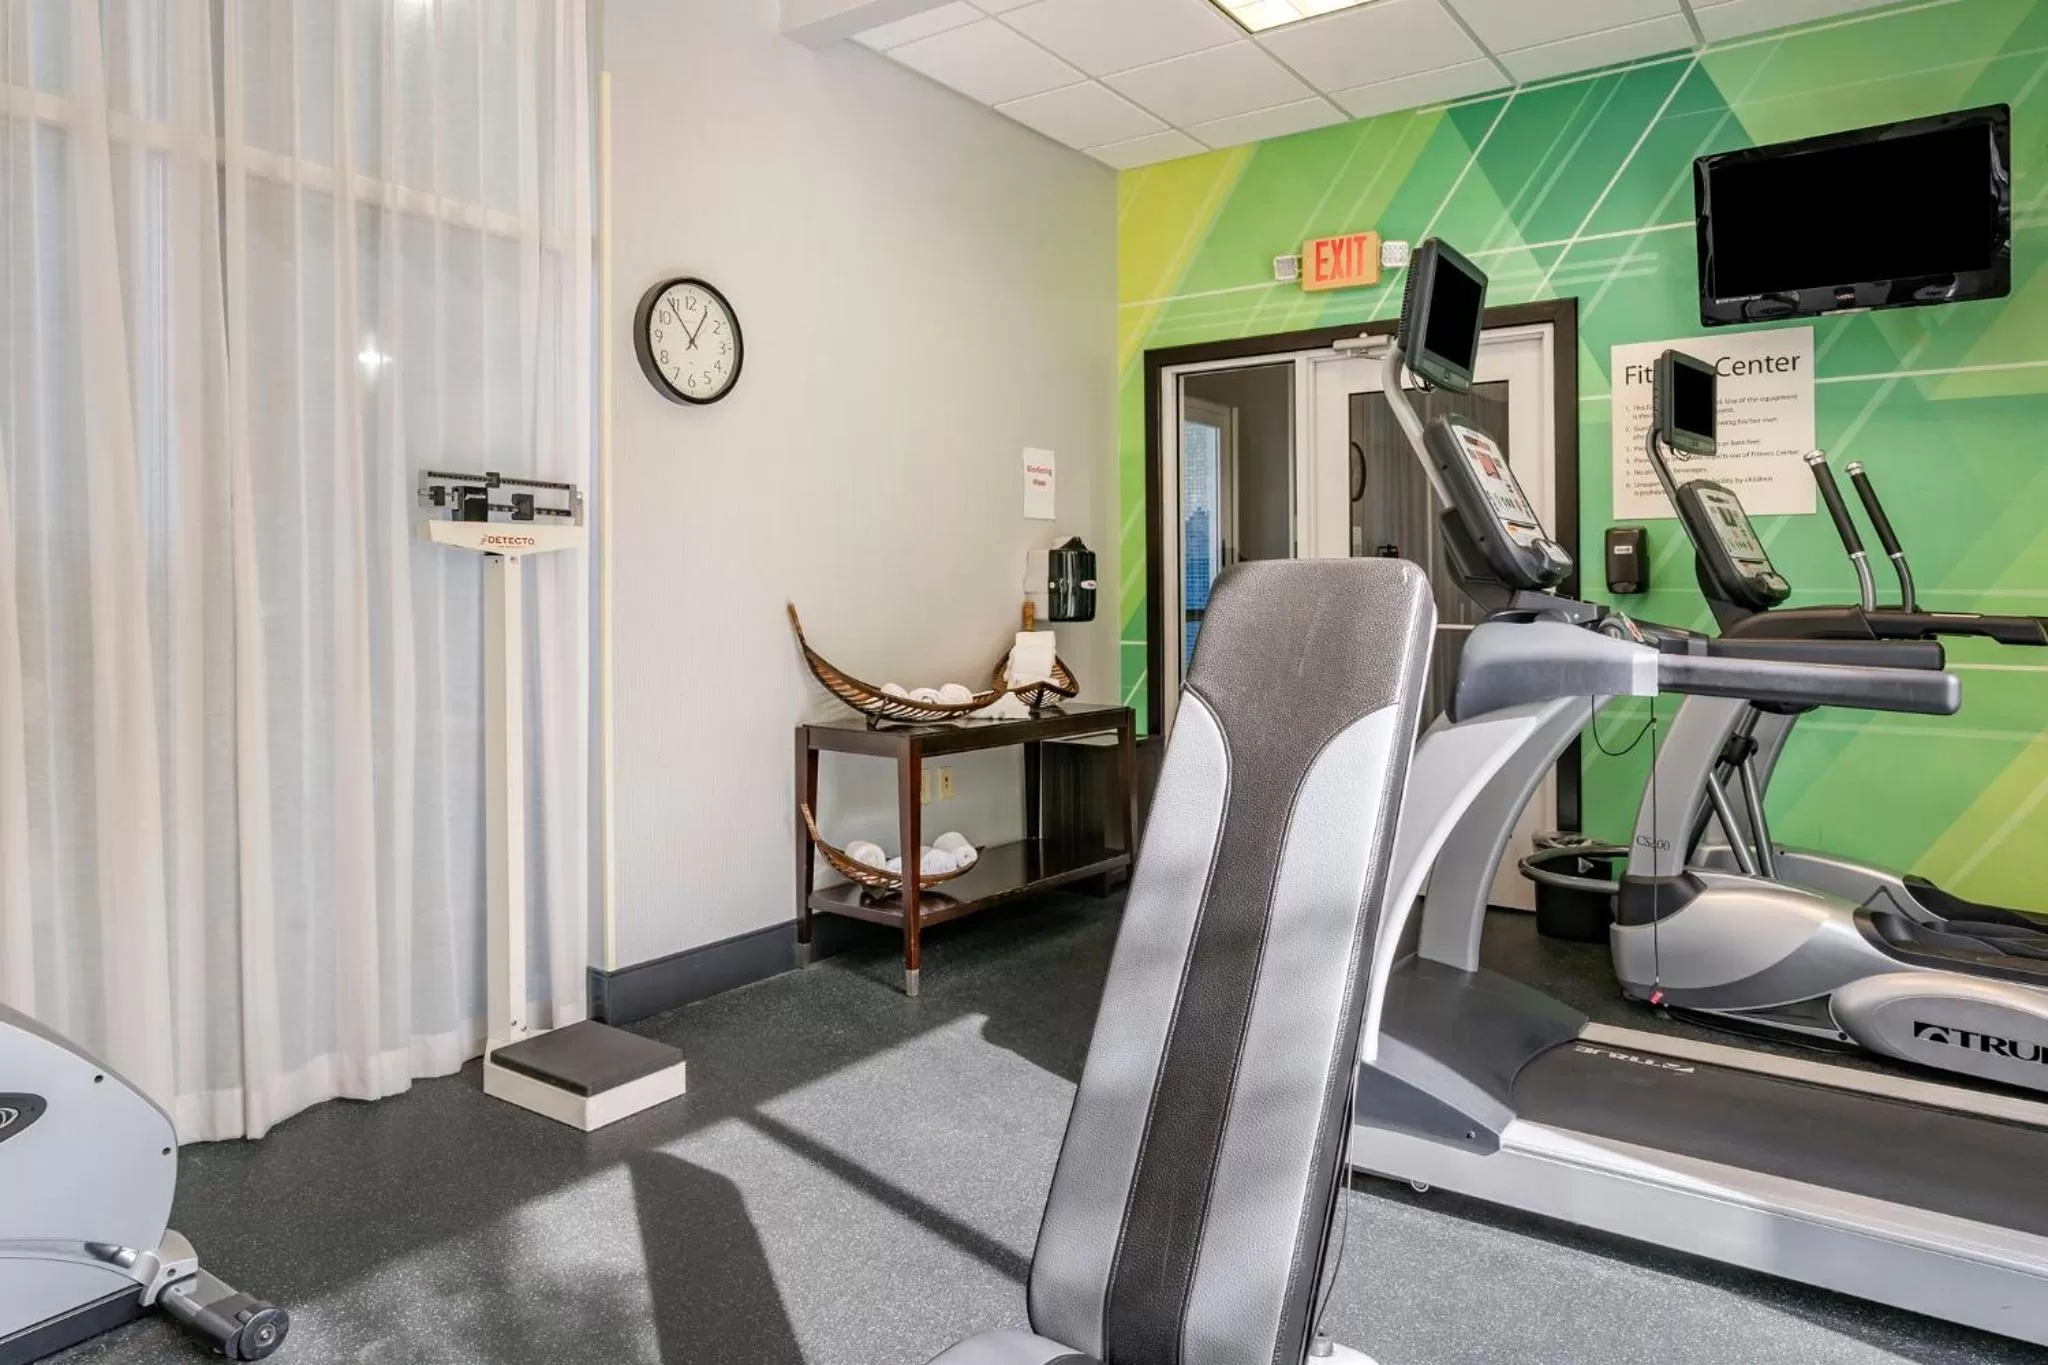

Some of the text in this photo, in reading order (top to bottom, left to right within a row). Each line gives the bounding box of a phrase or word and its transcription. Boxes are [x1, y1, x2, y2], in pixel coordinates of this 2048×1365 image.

[1315, 236, 1367, 281] EXIT
[685, 296, 697, 311] 12
[659, 310, 671, 325] 10
[713, 320, 721, 335] 2
[654, 329, 663, 343] 9
[718, 343, 726, 355] 3
[660, 350, 669, 364] 8
[713, 360, 721, 372] 4
[1715, 355, 1801, 377] Center
[673, 367, 680, 380] 7
[703, 371, 712, 384] 5
[687, 374, 696, 388] 6
[488, 535, 535, 545] DETECTO
